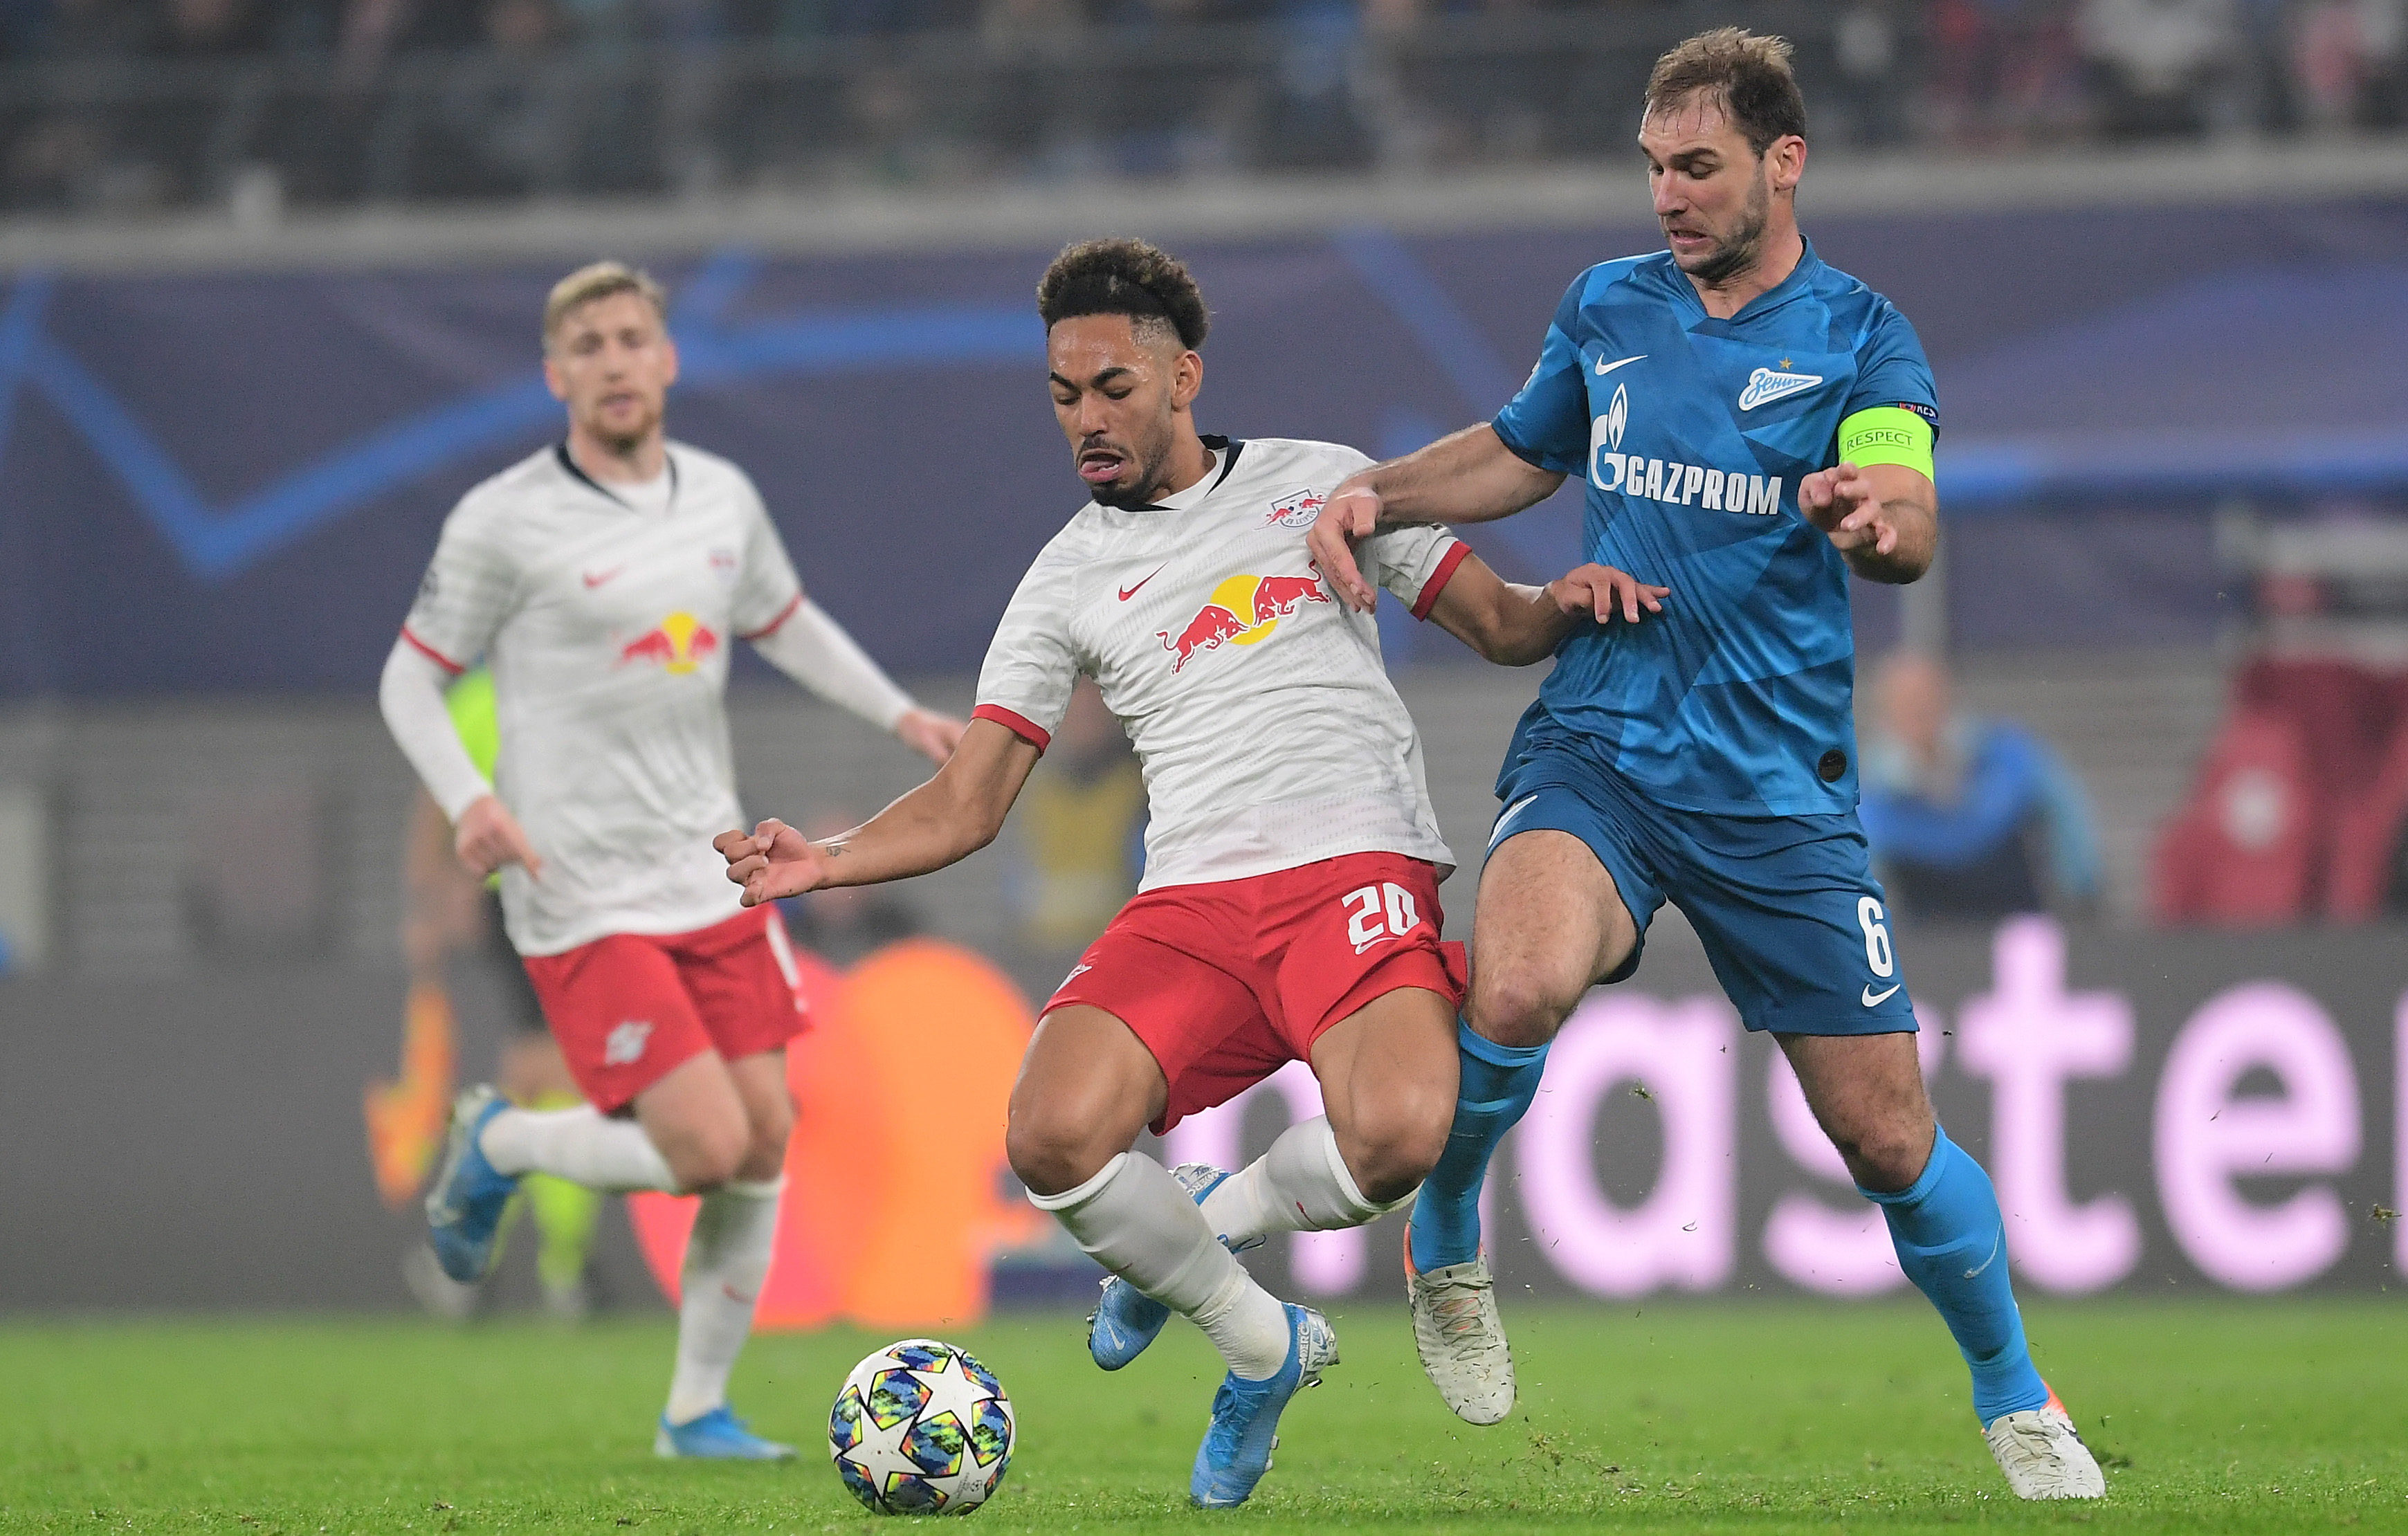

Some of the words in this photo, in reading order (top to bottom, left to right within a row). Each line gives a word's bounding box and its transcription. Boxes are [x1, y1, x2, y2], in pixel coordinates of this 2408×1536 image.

[1846, 431, 1913, 451] RESPECT
[1626, 455, 1782, 515] GAZPROM
[1341, 882, 1420, 945] 20
[1858, 896, 1893, 978] 6
[1164, 913, 2408, 1294] aste
